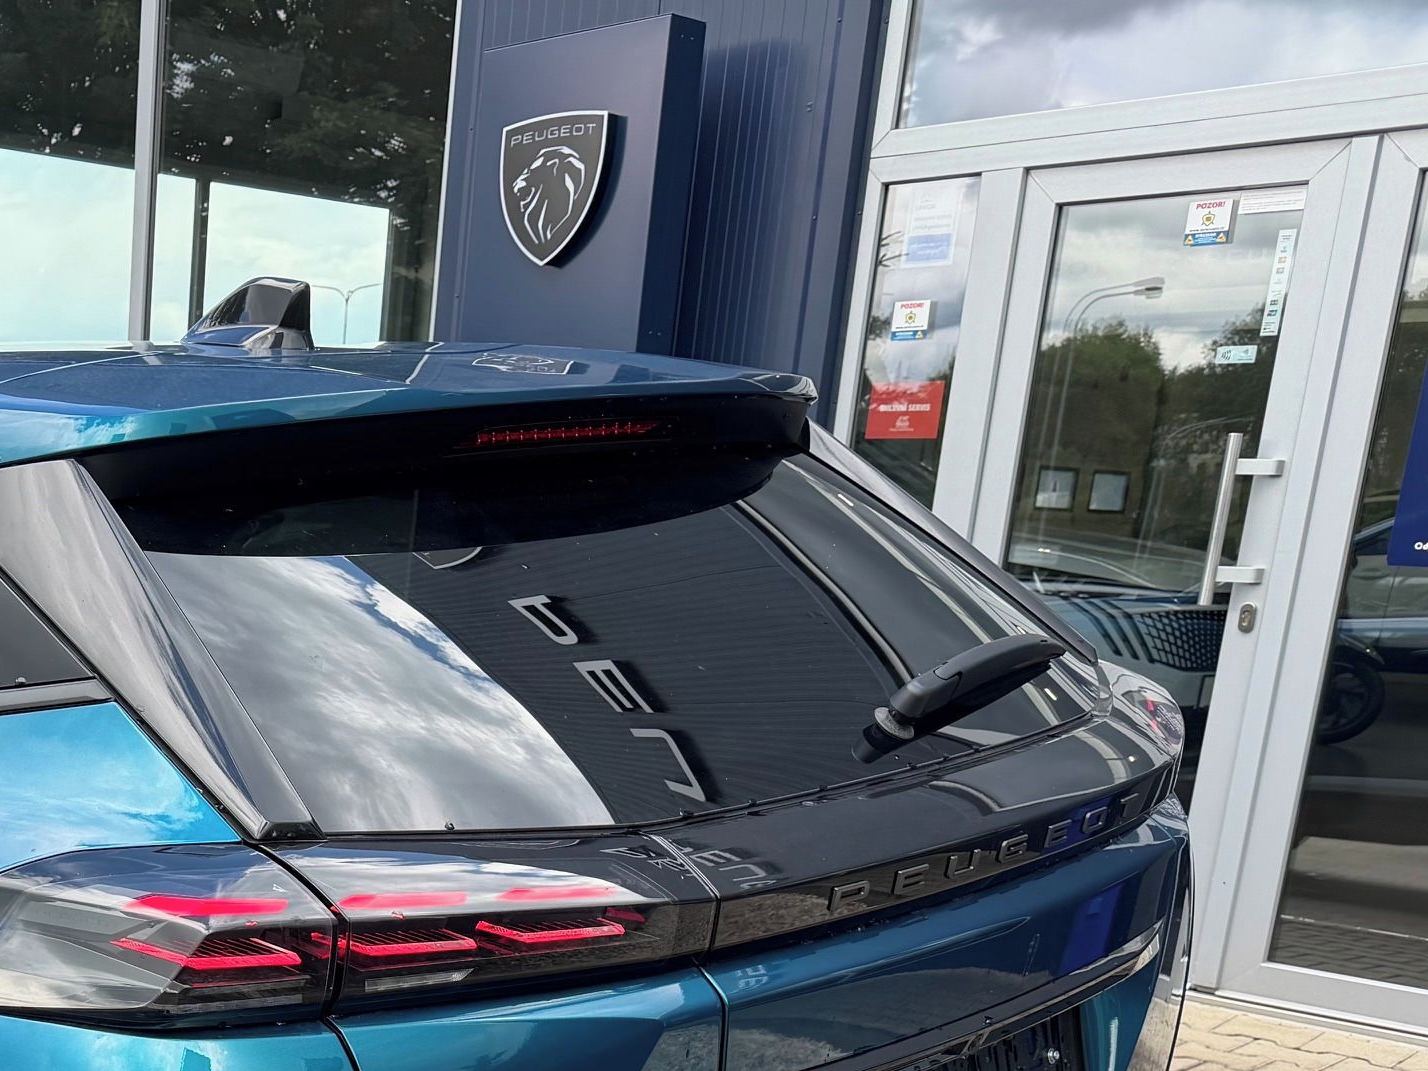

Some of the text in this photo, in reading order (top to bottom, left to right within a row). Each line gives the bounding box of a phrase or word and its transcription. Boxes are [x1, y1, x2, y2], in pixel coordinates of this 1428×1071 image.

[510, 122, 596, 148] PEUGEOT
[1196, 200, 1226, 210] POZOR!
[827, 791, 1141, 913] PEUGEOT
